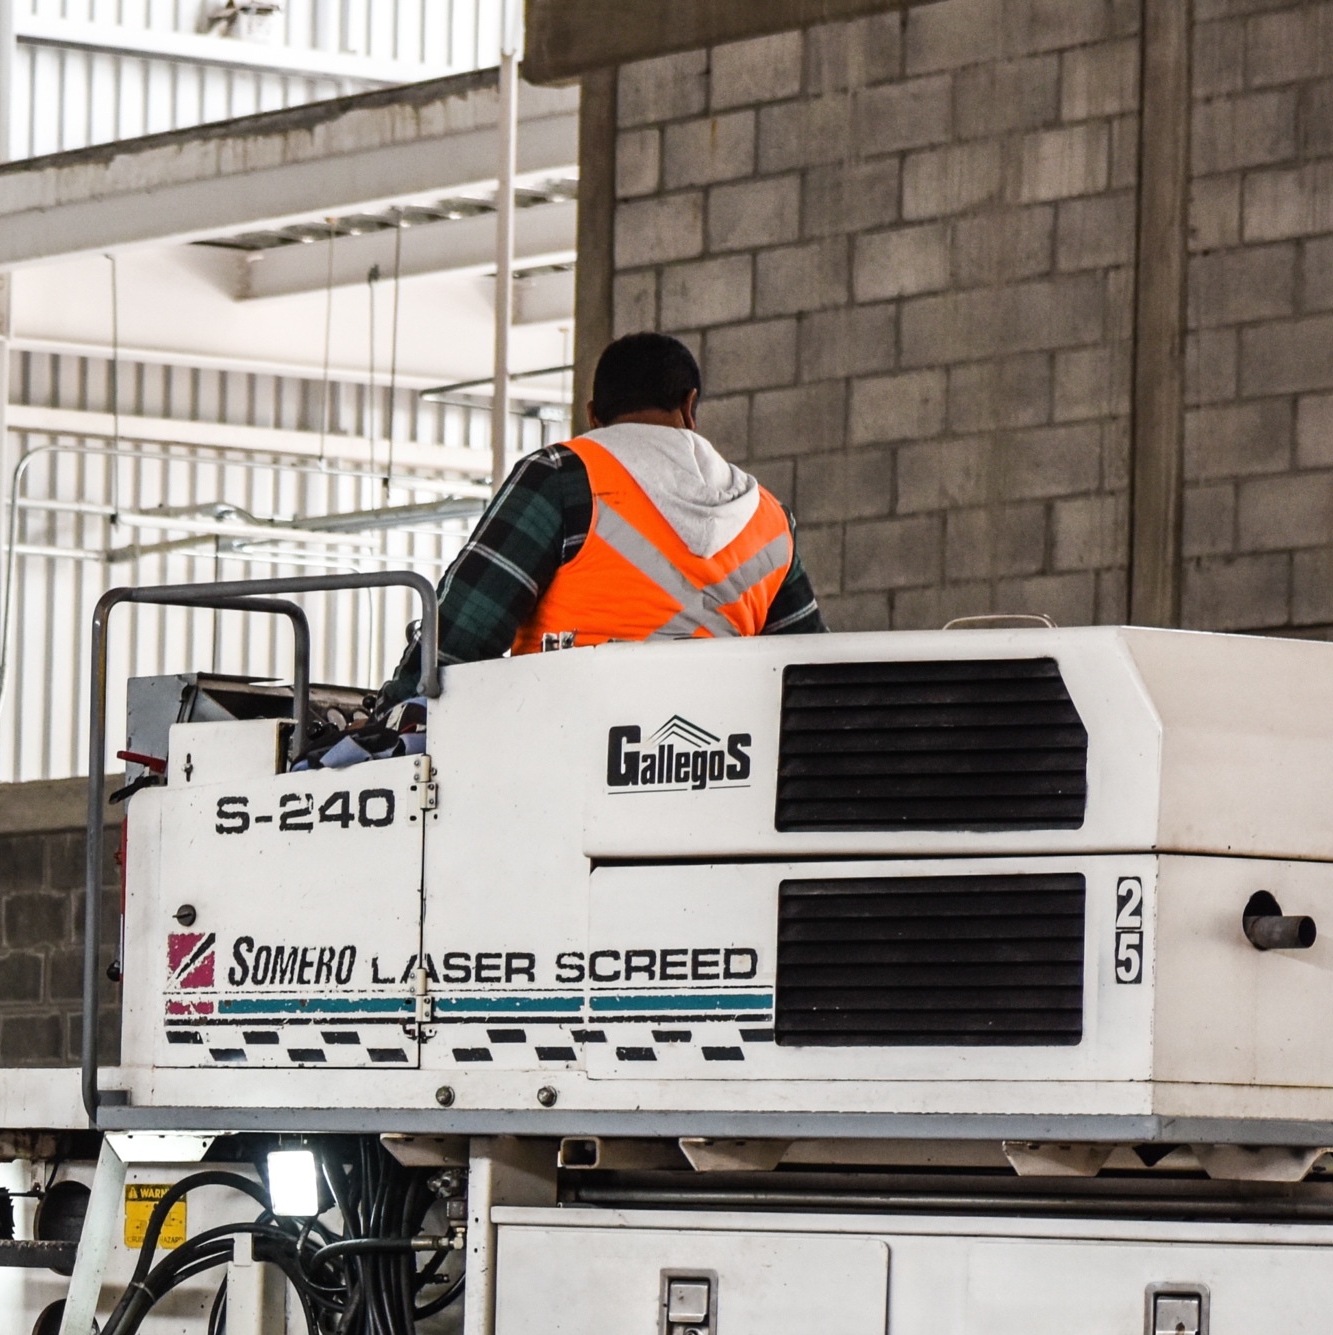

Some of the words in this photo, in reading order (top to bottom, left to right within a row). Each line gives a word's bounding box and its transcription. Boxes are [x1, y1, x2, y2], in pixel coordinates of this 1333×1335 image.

[215, 788, 395, 835] S-240
[229, 936, 357, 986] SOMERO
[371, 950, 536, 984] LASER
[555, 948, 758, 983] SCREED
